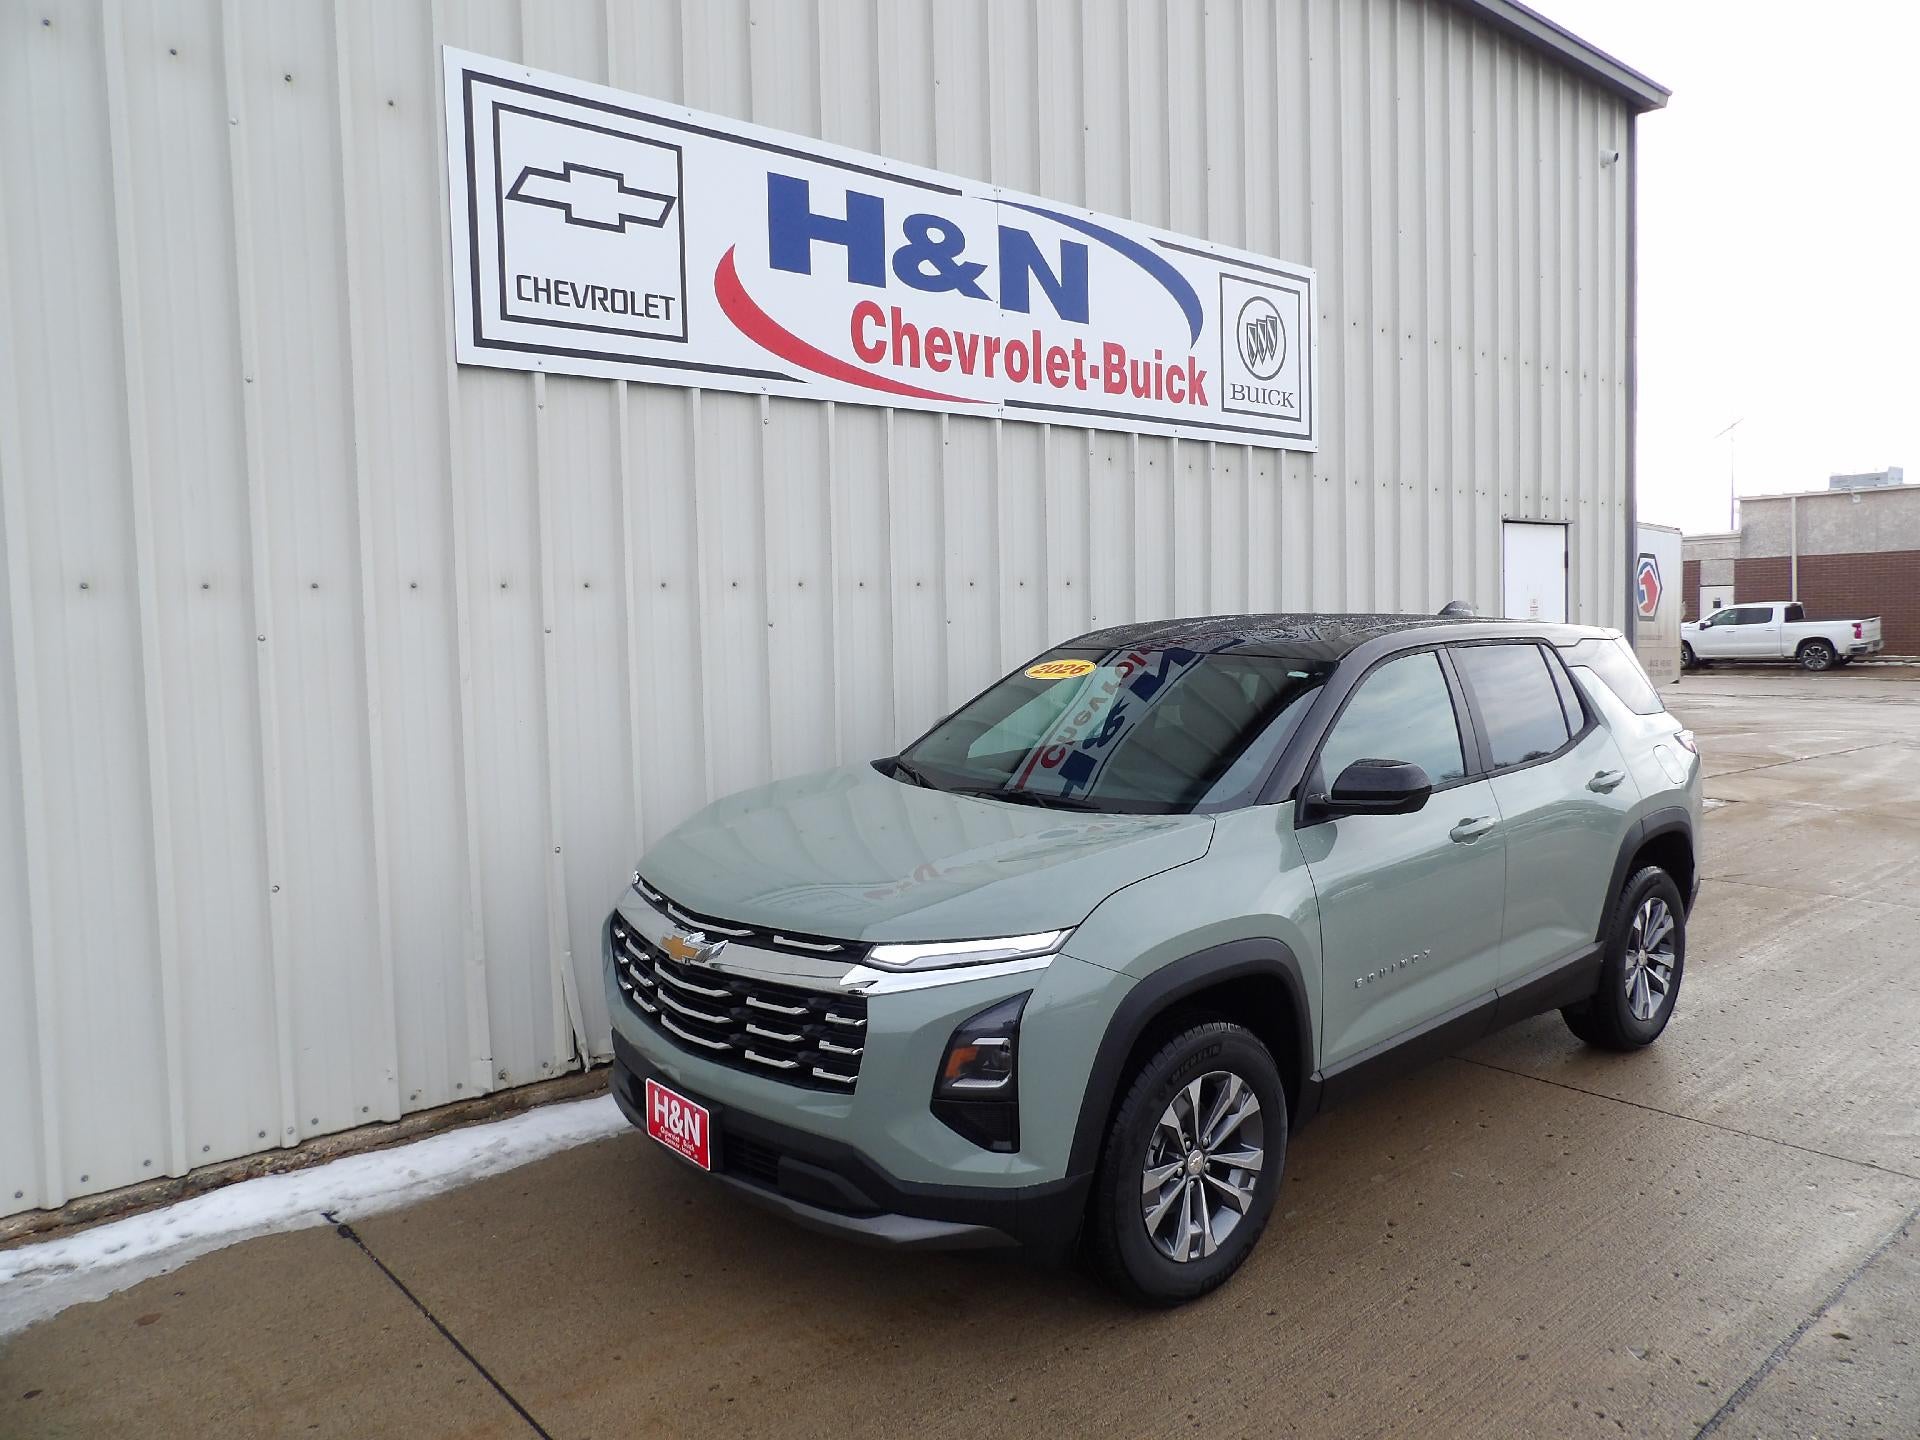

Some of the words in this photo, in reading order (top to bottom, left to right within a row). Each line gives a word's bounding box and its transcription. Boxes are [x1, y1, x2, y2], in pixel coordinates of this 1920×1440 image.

[768, 173, 1088, 324] H&N
[516, 274, 676, 320] CHEVROLET
[851, 301, 1208, 406] Chevrolet-Buick
[1229, 382, 1295, 408] BUICK
[1030, 663, 1091, 674] 2026
[654, 1089, 700, 1147] H&N
